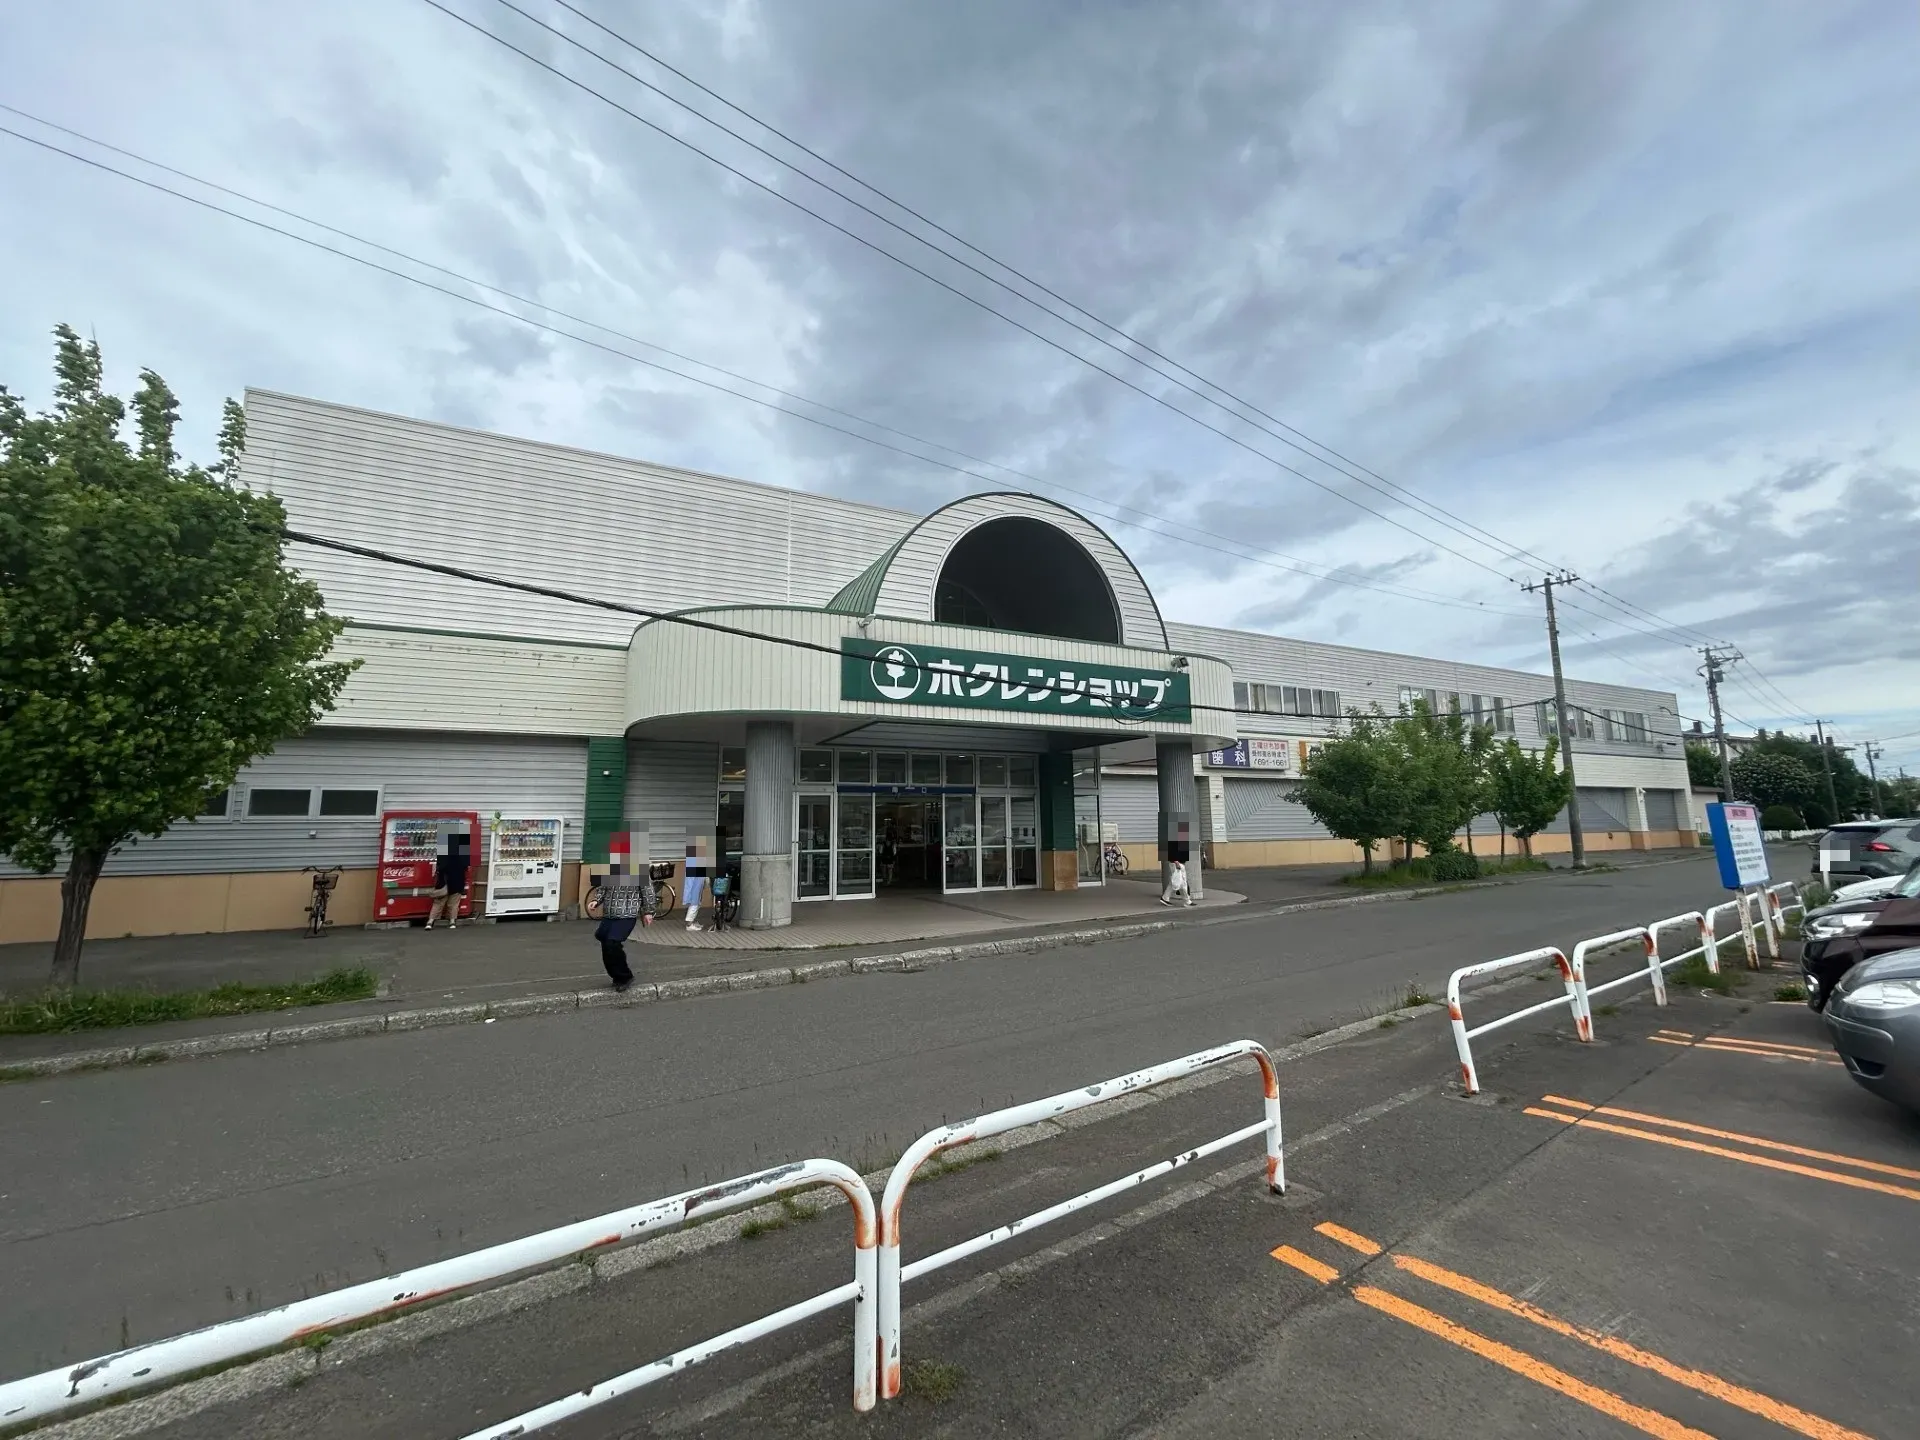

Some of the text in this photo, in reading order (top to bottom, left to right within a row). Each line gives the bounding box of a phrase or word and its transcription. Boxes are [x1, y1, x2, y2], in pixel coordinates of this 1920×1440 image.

[926, 659, 1172, 710] ホクレンショップ
[1211, 750, 1246, 766] 歯科
